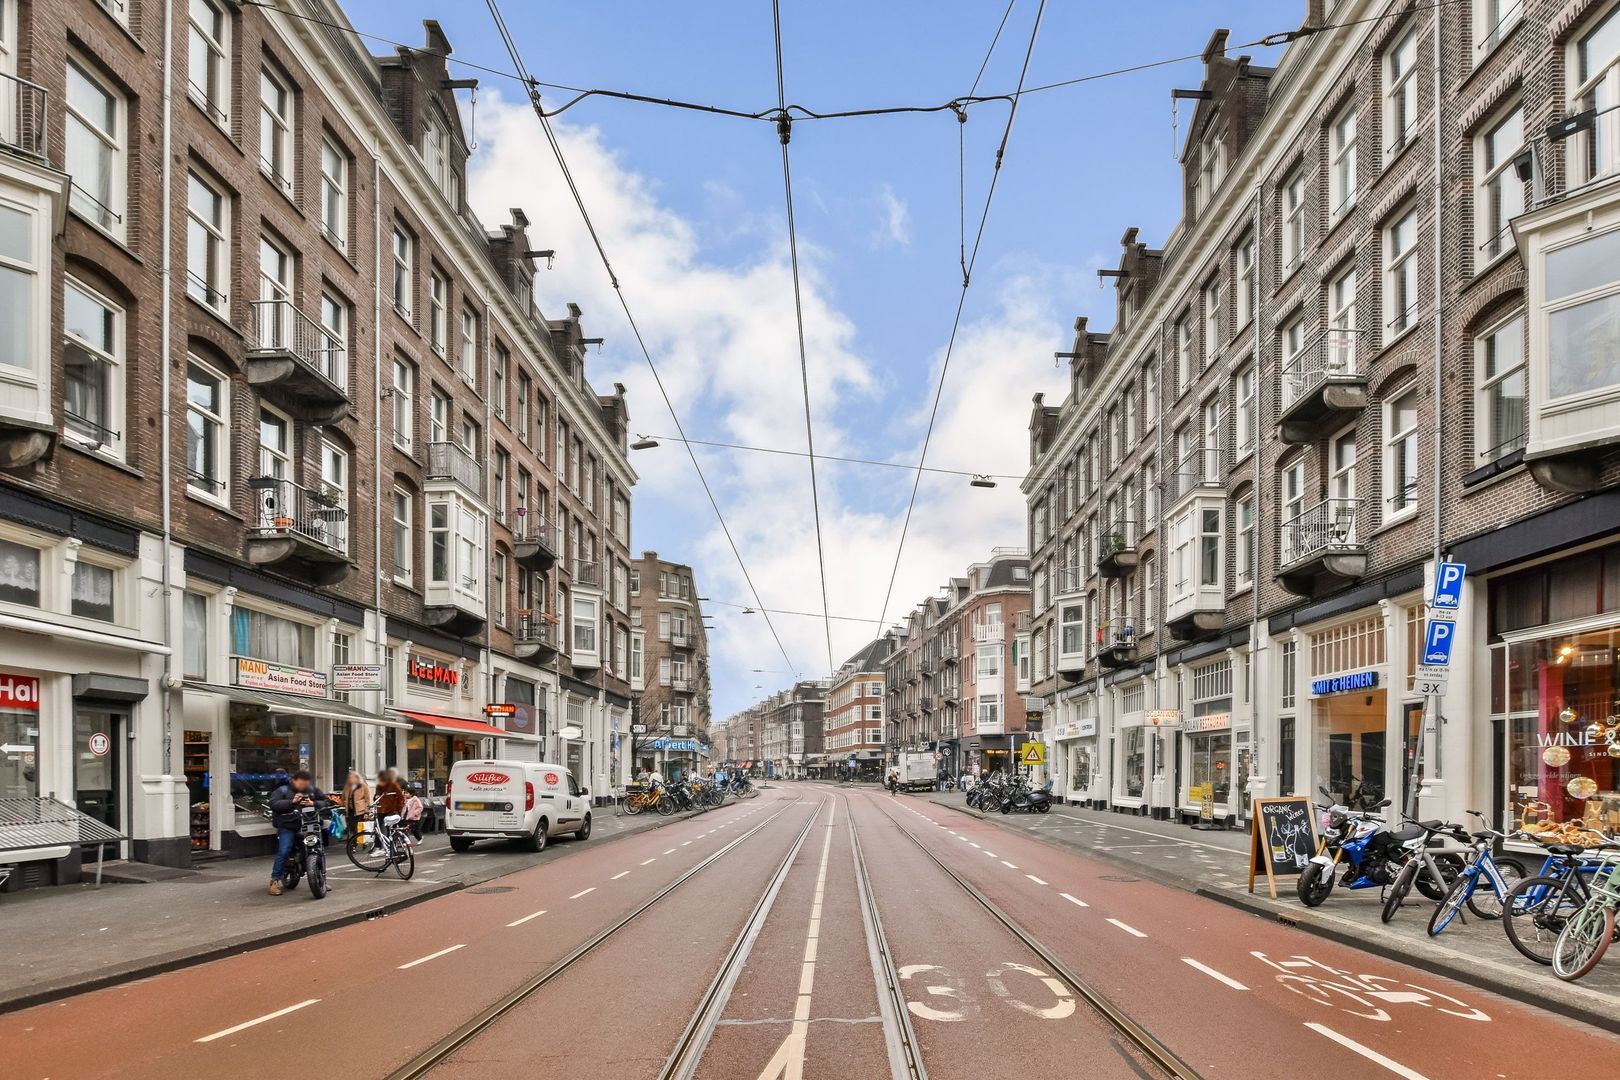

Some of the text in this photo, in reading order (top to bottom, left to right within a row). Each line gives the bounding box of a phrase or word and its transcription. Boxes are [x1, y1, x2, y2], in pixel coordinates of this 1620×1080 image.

[1442, 566, 1460, 589] P
[1432, 624, 1449, 646] P
[240, 660, 268, 674] MANU
[268, 673, 288, 683] Asian
[290, 676, 306, 686] Food
[308, 680, 326, 690] Store
[1312, 672, 1373, 694] SMIT & HEINEN
[1536, 728, 1617, 746] WINE &
[1263, 804, 1292, 814] ORGANIC
